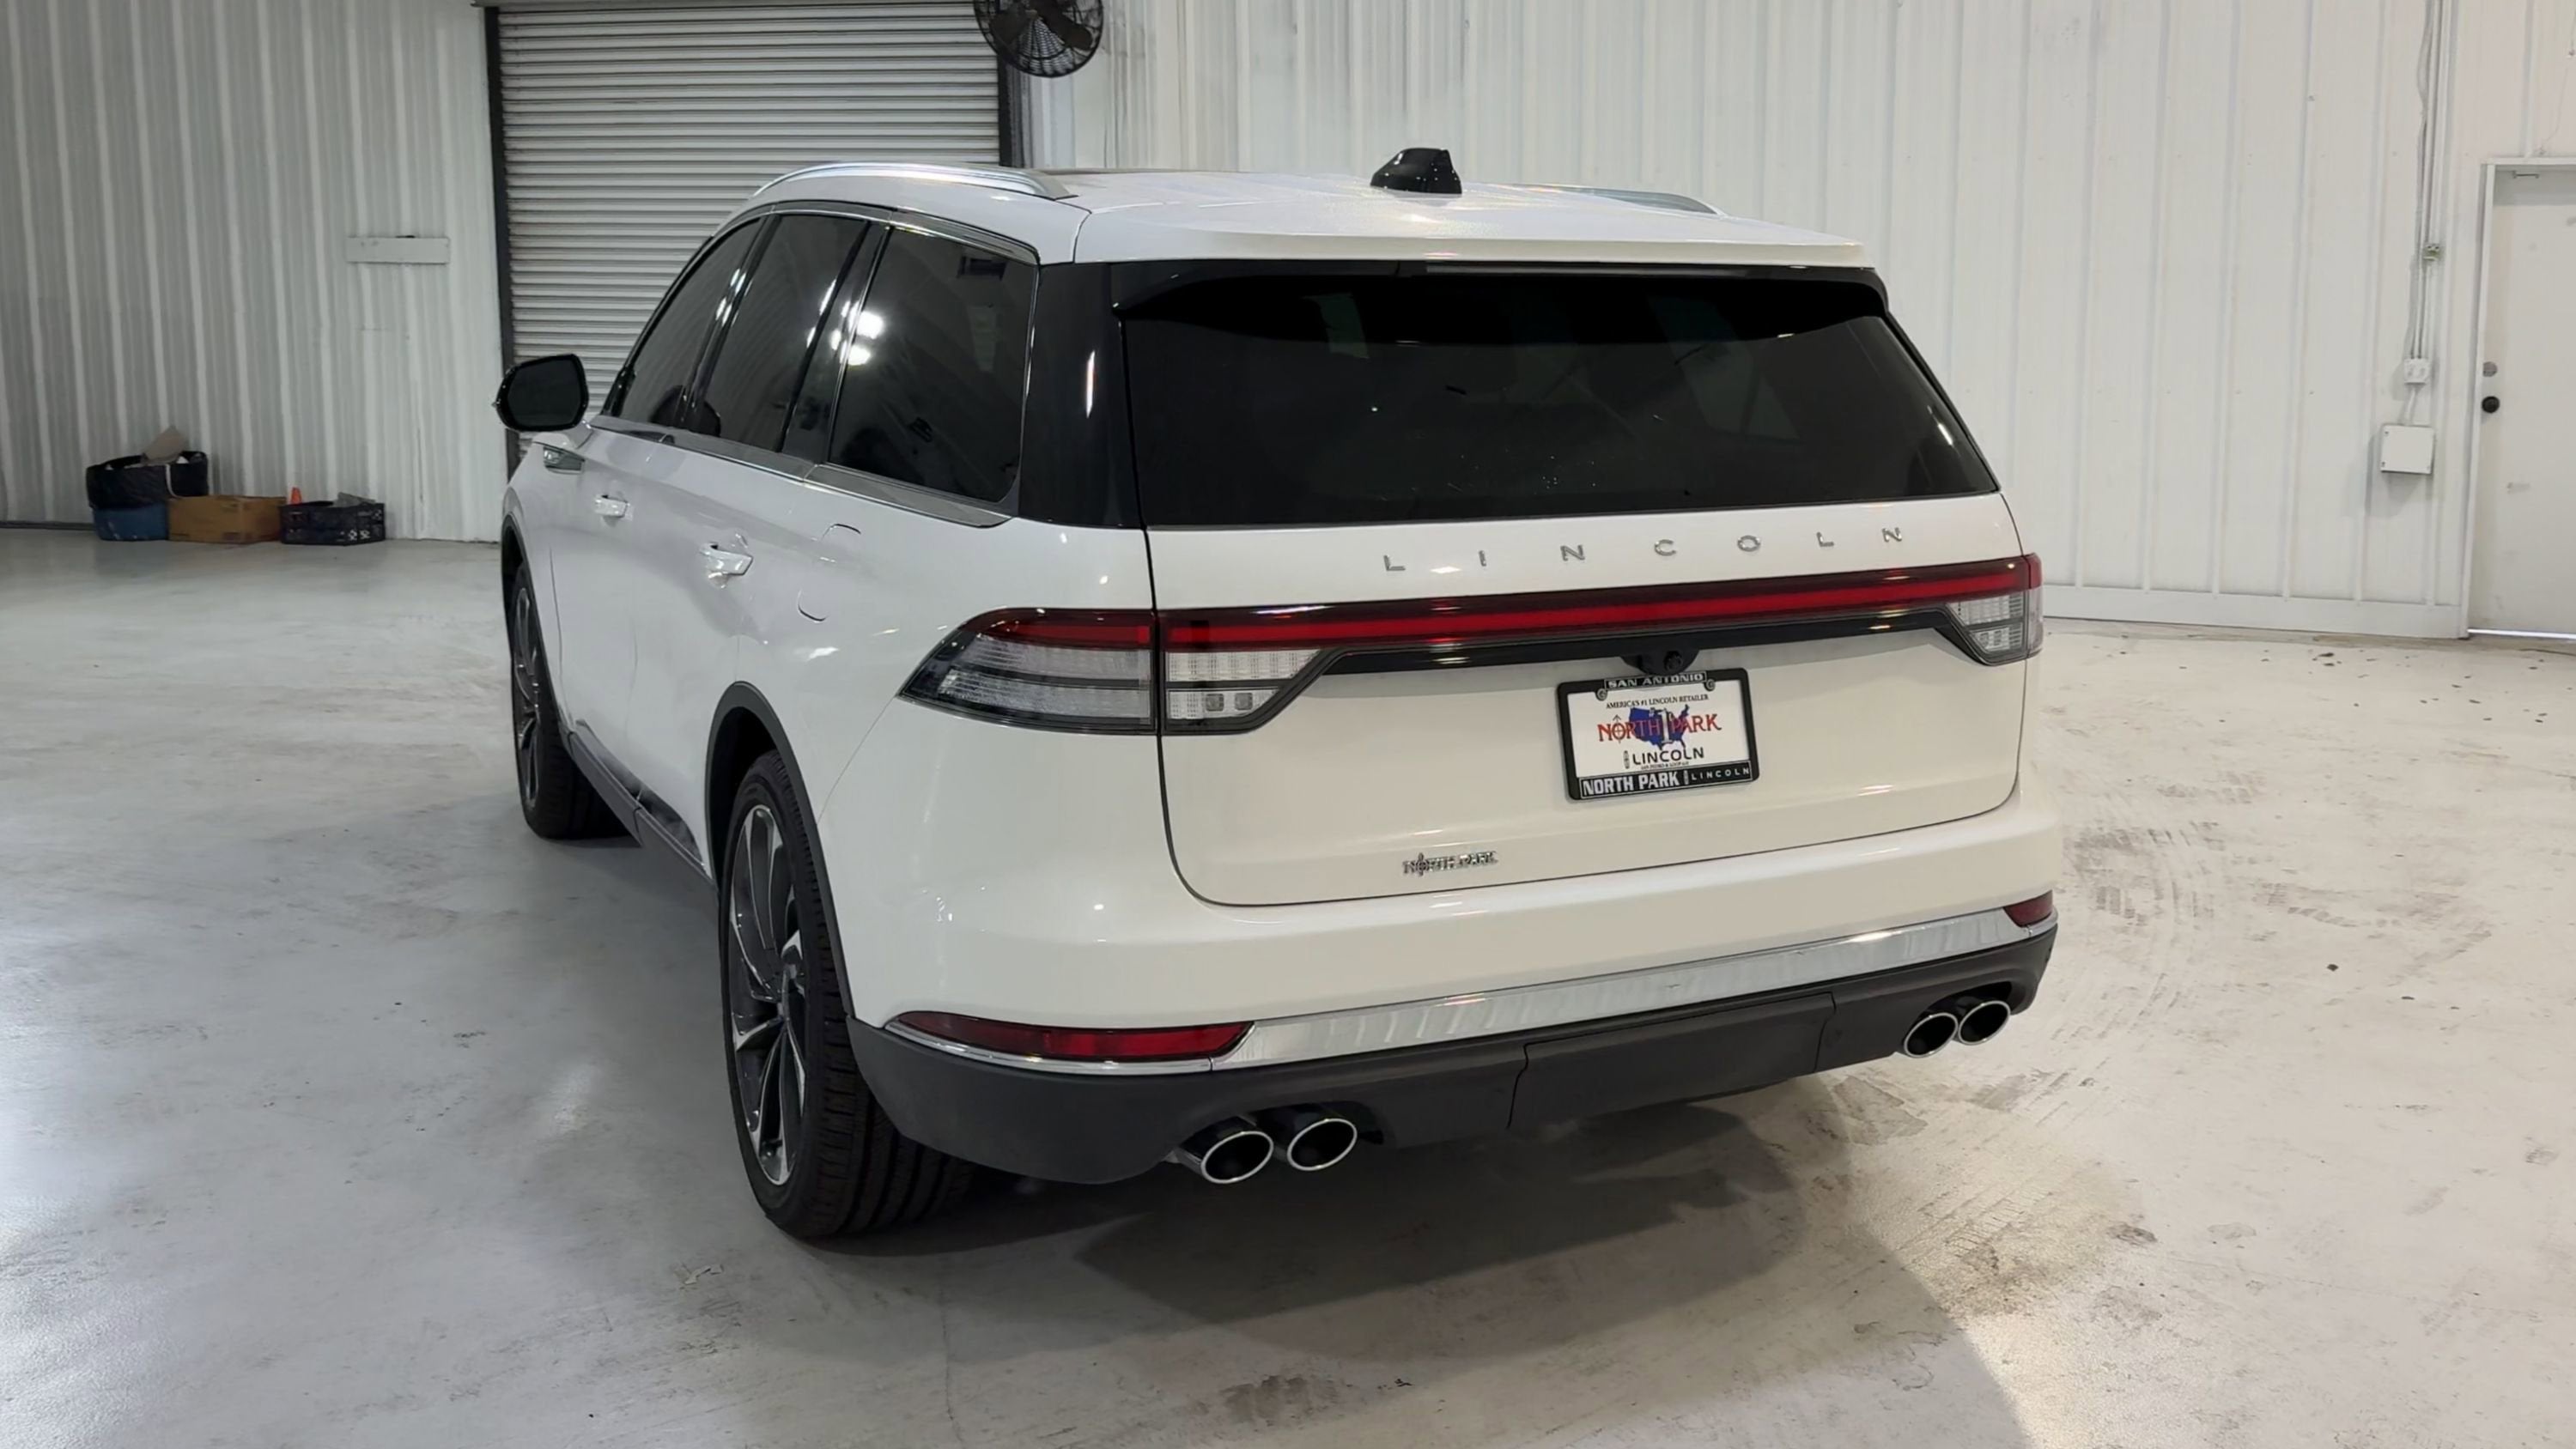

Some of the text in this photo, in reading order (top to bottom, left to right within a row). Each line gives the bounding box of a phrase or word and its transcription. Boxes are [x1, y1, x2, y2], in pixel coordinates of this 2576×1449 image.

[1383, 526, 1903, 572] LINCOLN
[1607, 673, 1704, 688] SAN ANTONIO
[1606, 700, 1639, 709] AMERICA'S
[1649, 696, 1678, 705] LINCOLN
[1679, 694, 1709, 702] RETAILER
[1597, 713, 1722, 743] NORTH PARK
[1632, 747, 1704, 766] LINCOLN
[1583, 767, 1750, 797] NORTH PARK LINCOLN
[1402, 851, 1498, 876] NORTH PARK
